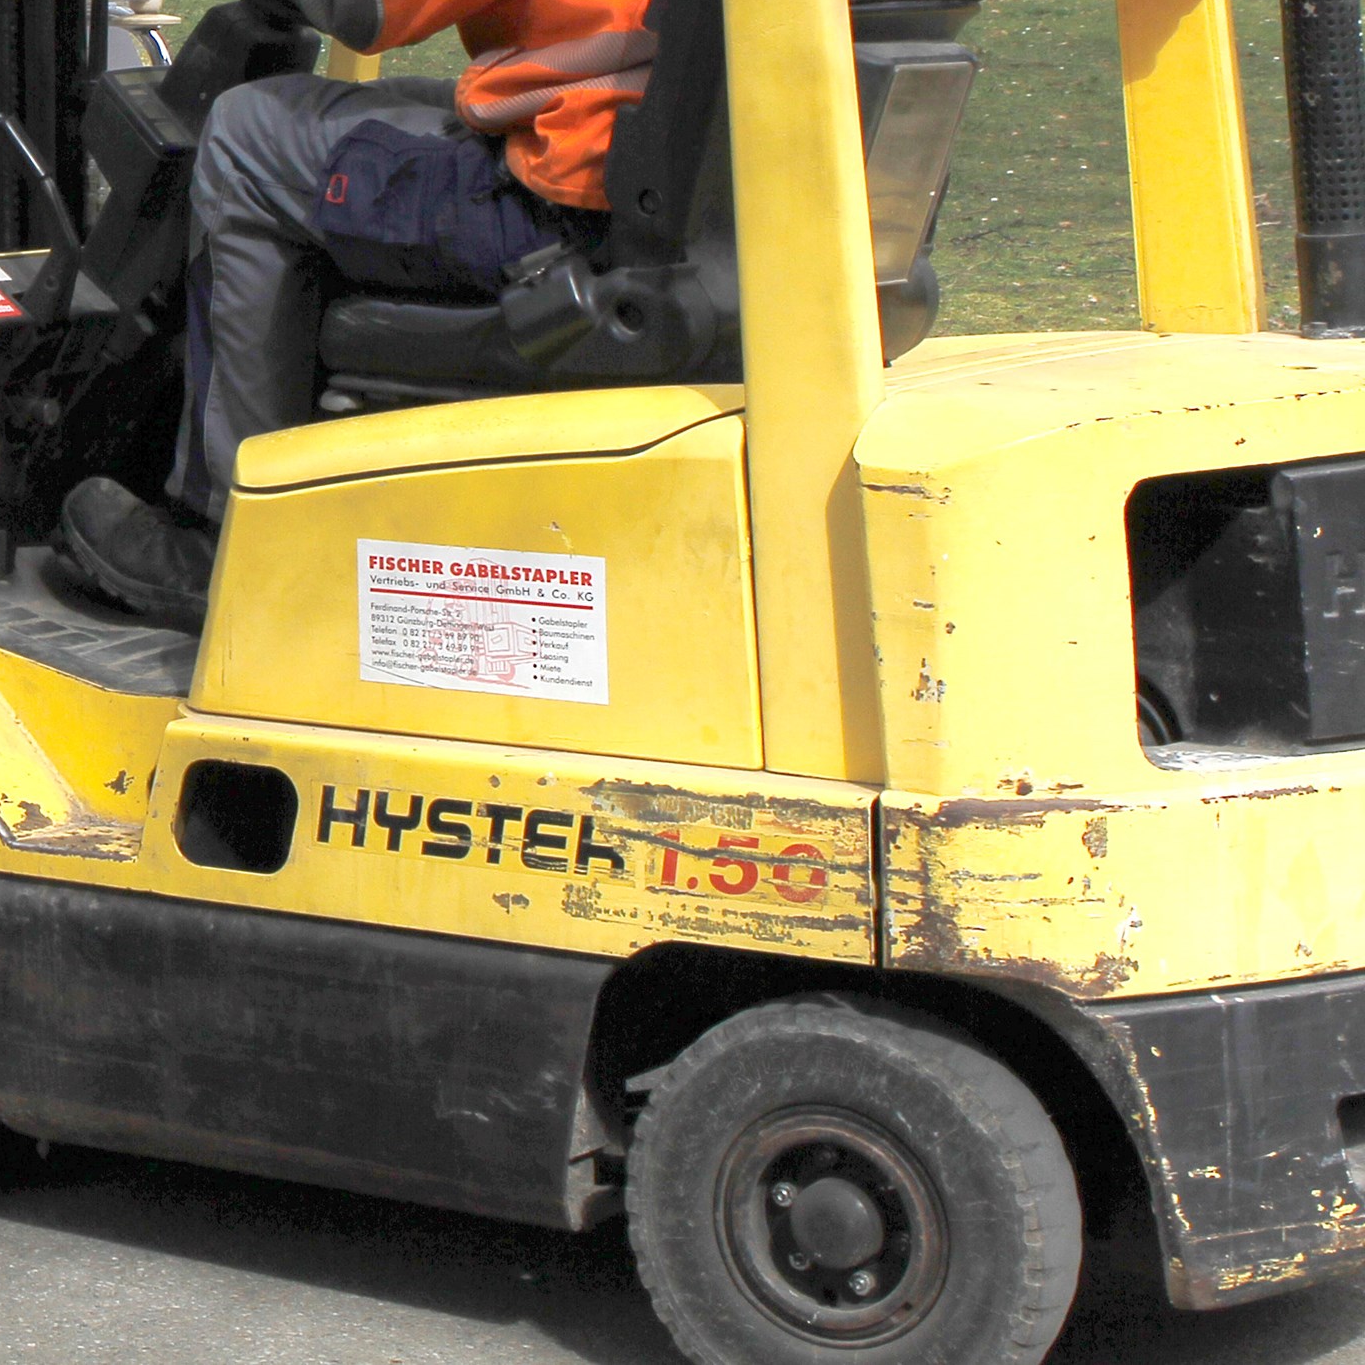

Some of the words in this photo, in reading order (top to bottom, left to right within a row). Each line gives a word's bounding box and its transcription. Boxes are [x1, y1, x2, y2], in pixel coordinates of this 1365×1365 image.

[368, 555, 444, 575] FISCHER
[449, 562, 593, 587] GABELSTAPLER
[370, 575, 419, 588] Vertriebs-
[425, 580, 446, 590] und
[452, 581, 489, 594] Service
[496, 584, 530, 597] GmbH
[537, 588, 545, 598] &
[552, 588, 570, 600] Co.
[577, 591, 594, 602] KG
[371, 613, 395, 623] 89312
[538, 616, 587, 629] Gabelstapler
[371, 624, 398, 635] Telefon
[410, 629, 419, 637] 82
[539, 628, 595, 640] Baumaschinen
[372, 635, 397, 646] Telefax
[411, 640, 420, 648] 82
[539, 640, 569, 650] Verkauf
[540, 652, 569, 663] Leasing
[540, 664, 562, 673] Miete
[540, 675, 593, 687] Kundendienst
[316, 784, 626, 880] HYSTER
[656, 829, 828, 904] 1.50
